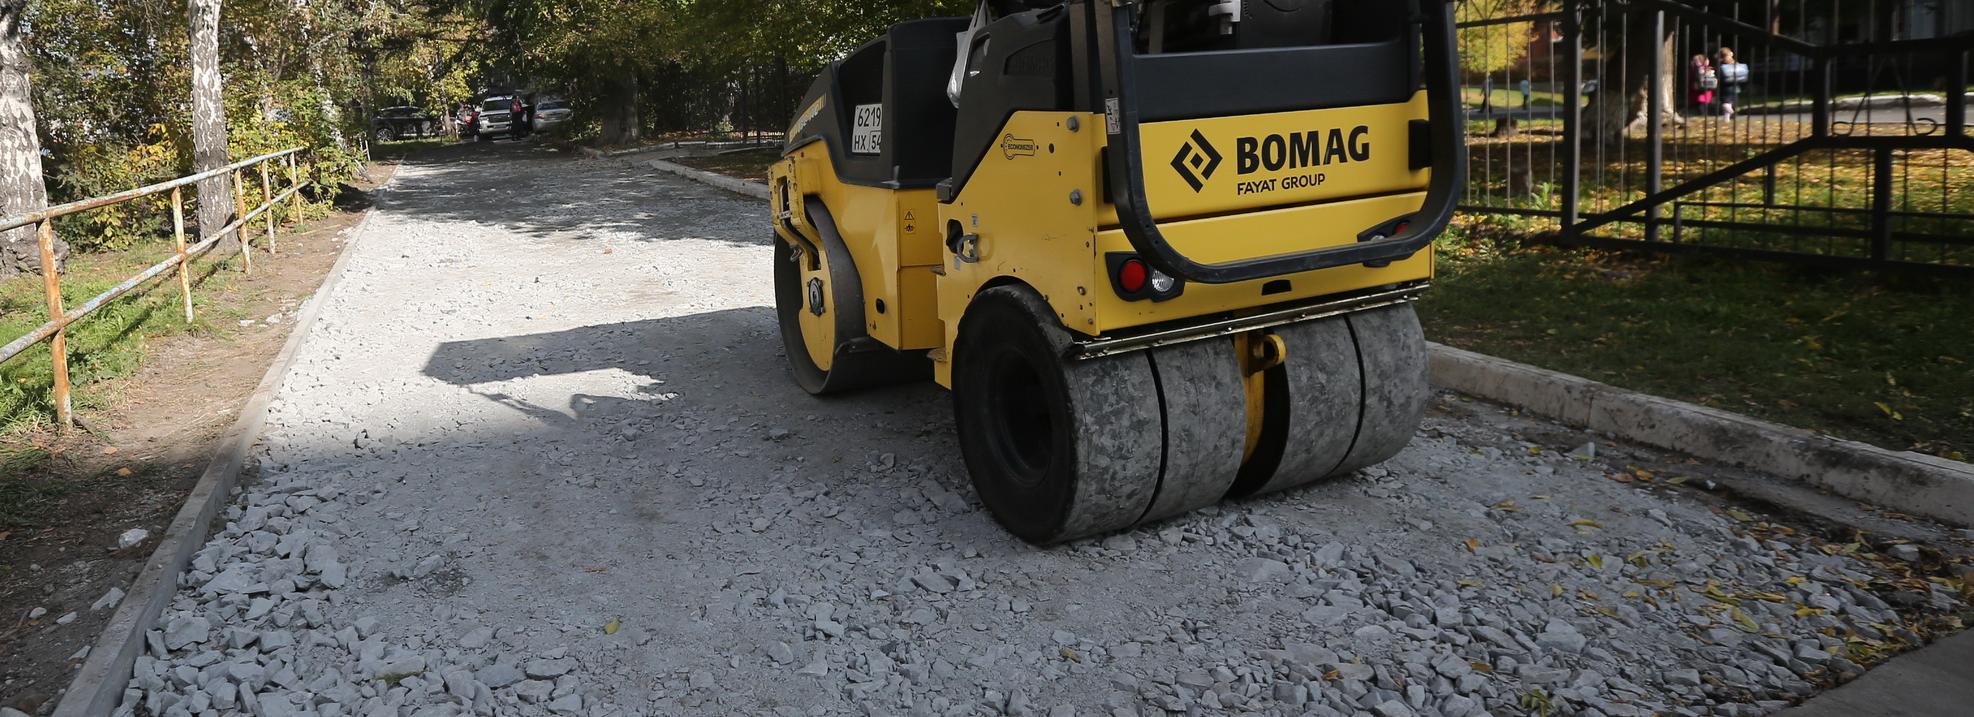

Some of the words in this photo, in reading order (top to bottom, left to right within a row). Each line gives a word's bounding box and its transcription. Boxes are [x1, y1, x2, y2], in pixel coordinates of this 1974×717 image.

[858, 107, 881, 127] 6219
[1236, 125, 1370, 175] BOMAG
[1237, 178, 1277, 195] FAYAT
[1281, 173, 1326, 190] GROUP
